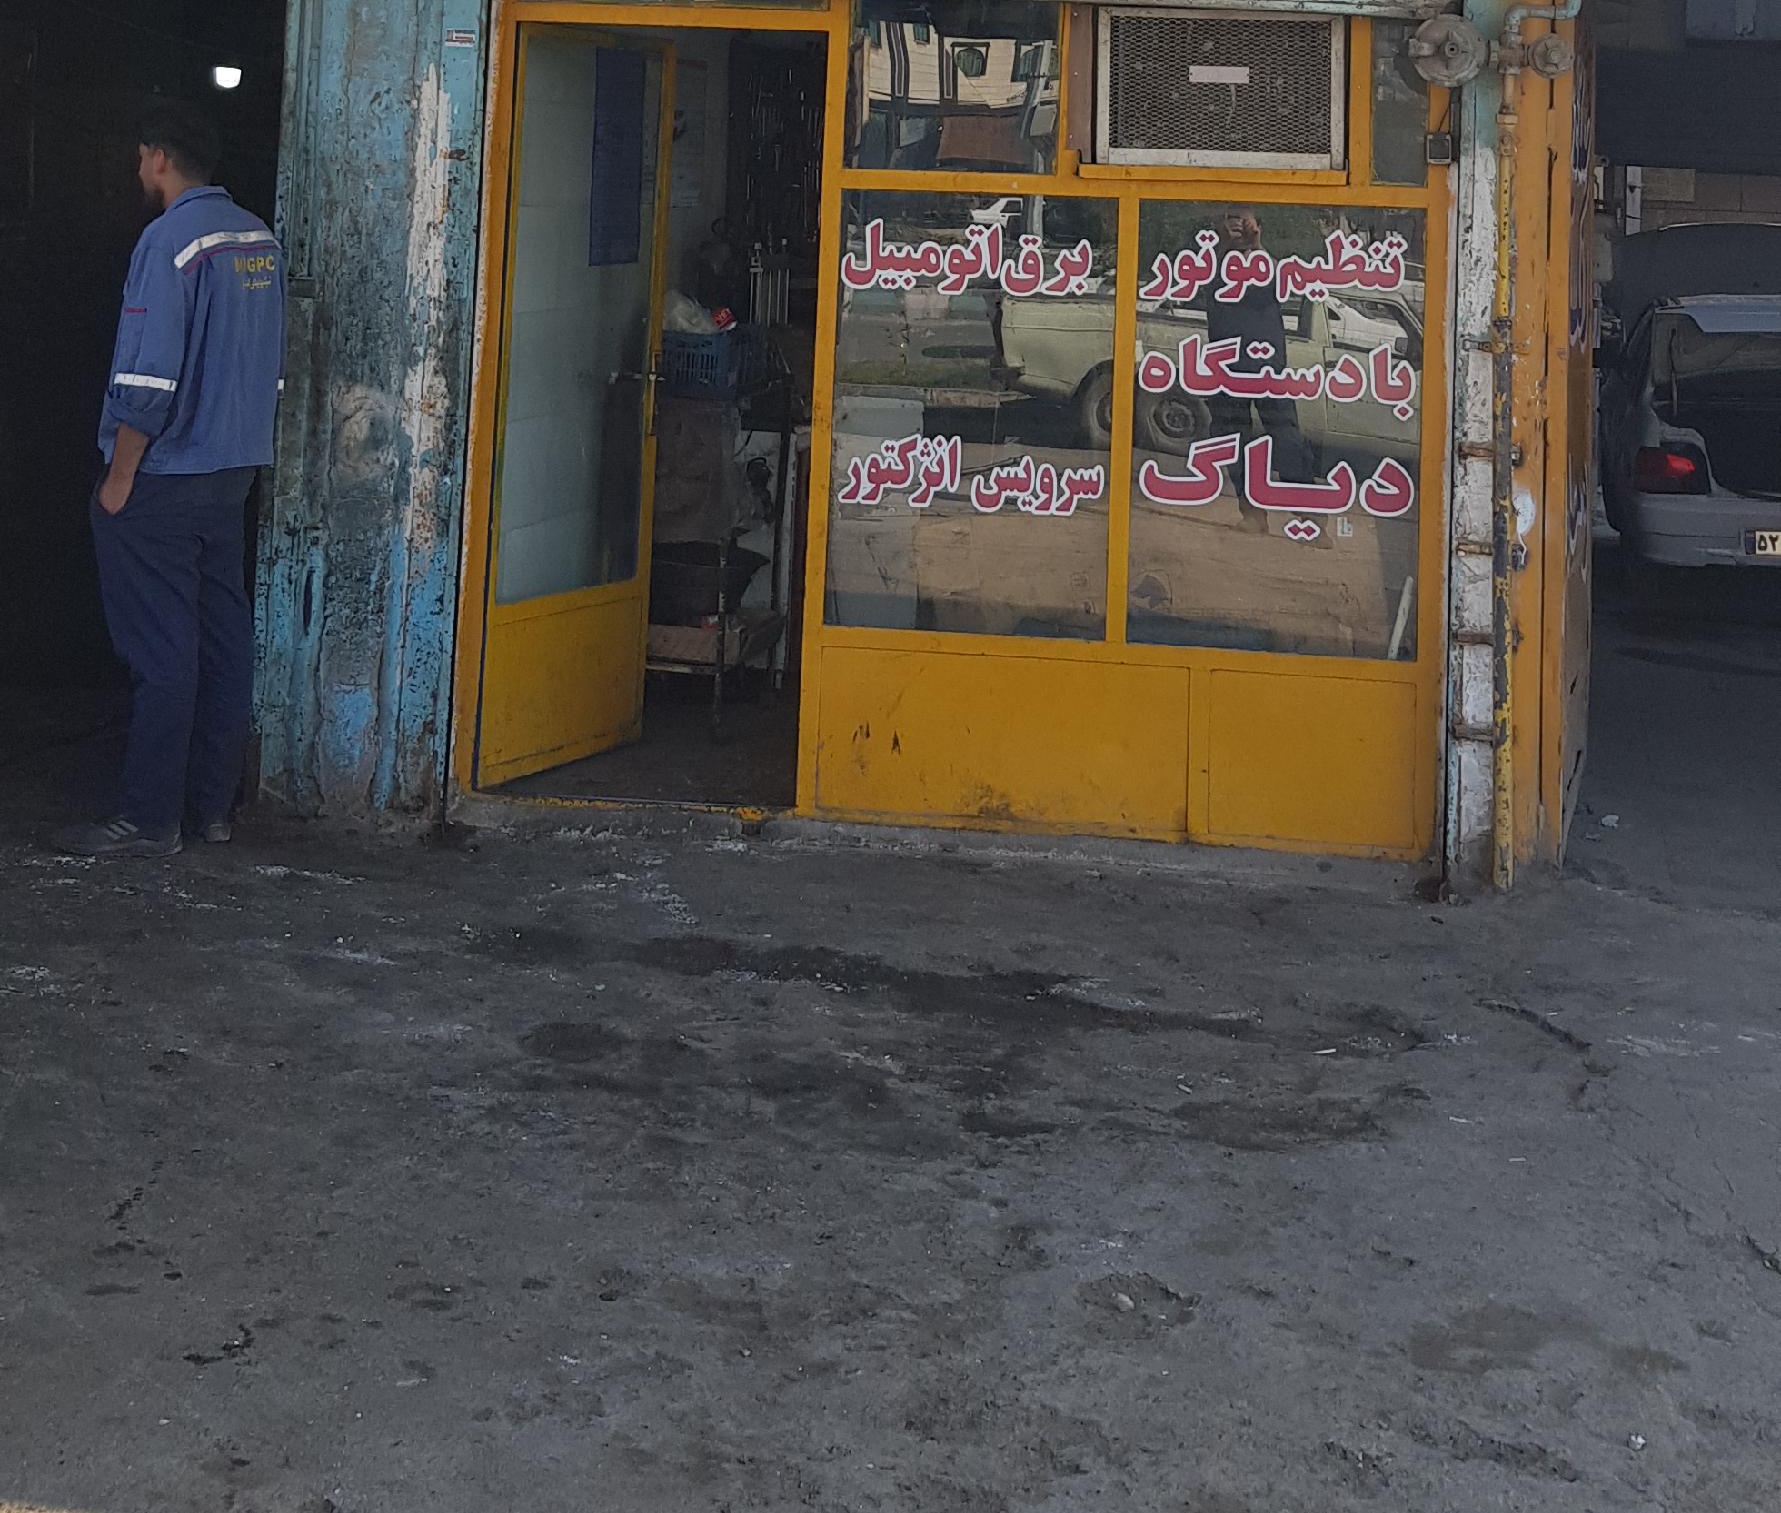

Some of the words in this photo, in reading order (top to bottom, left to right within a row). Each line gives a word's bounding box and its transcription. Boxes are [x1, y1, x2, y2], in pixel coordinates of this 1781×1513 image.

[840, 218, 1003, 296] اتومبیل
[1001, 232, 1094, 297] برق
[1138, 229, 1276, 303] موتور
[1275, 229, 1408, 303] تنظیم
[837, 433, 962, 508] انژکتور
[970, 454, 1105, 516] سرویس
[1138, 432, 1415, 540] دیاگ
